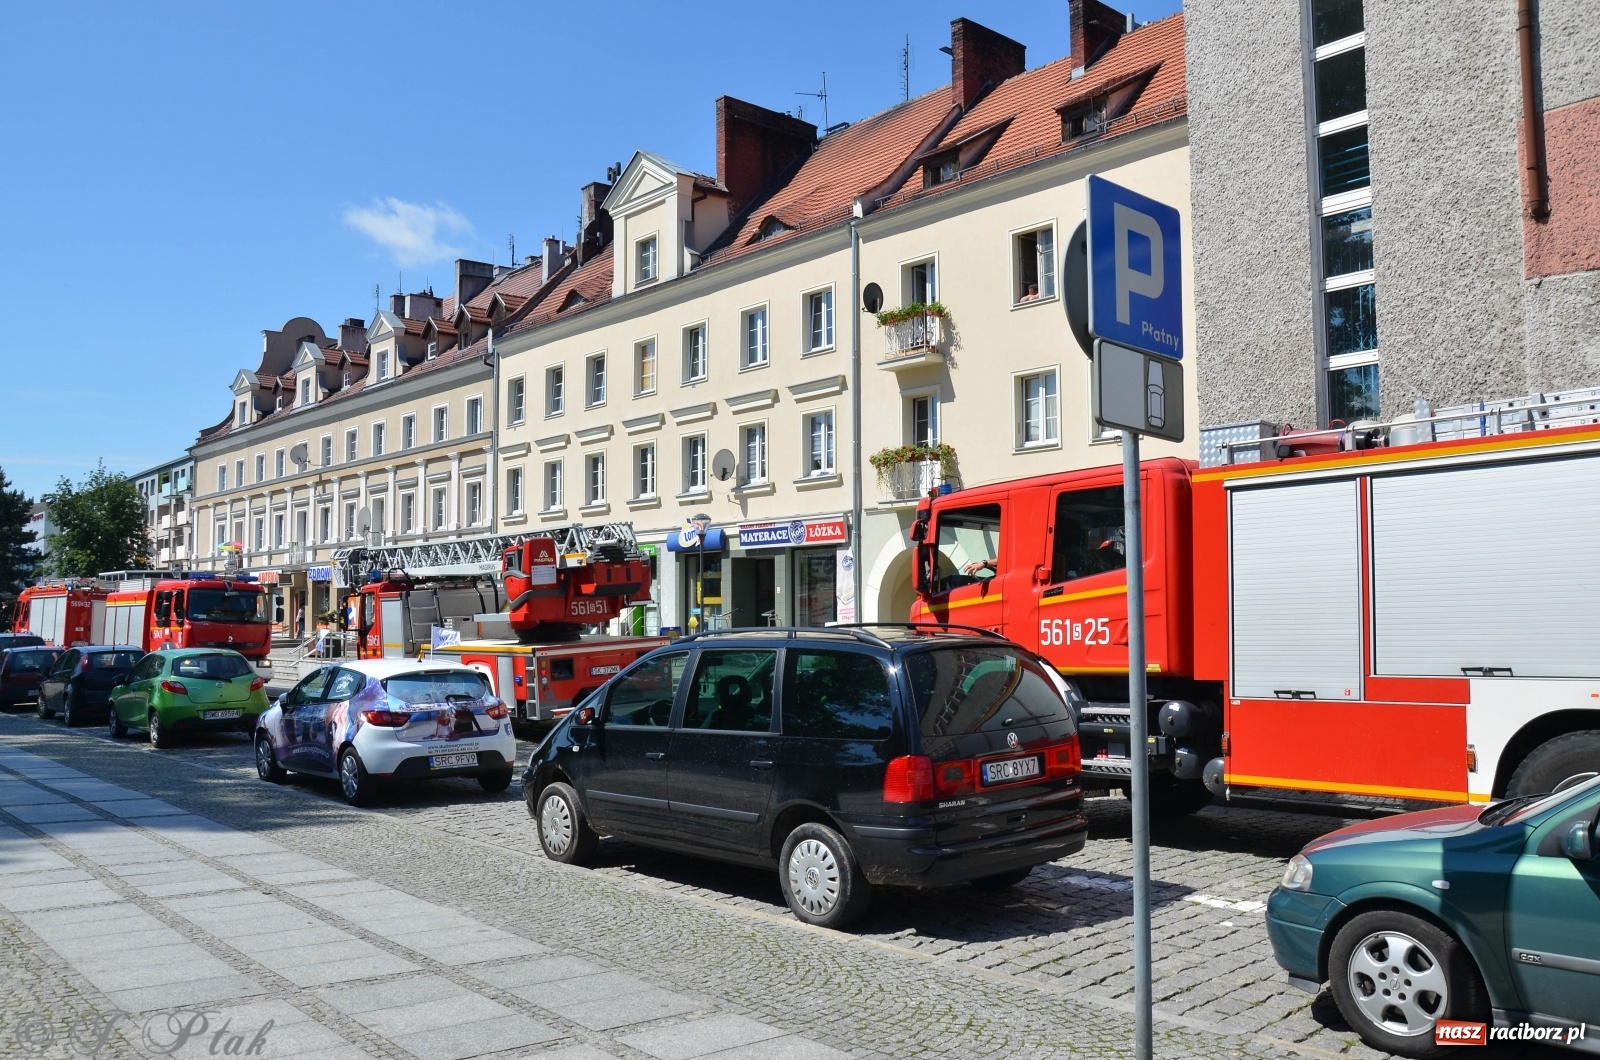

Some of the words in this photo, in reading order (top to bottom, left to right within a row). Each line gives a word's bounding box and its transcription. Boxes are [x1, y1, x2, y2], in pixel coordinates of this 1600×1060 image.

[1114, 202, 1164, 325] P
[740, 530, 788, 543] MATERACE
[809, 524, 842, 538] ŁÓŻKA
[479, 563, 496, 571] MAGIRUS
[435, 755, 453, 766] SRC
[456, 753, 476, 764] 9FV9
[989, 763, 1009, 781] SRC
[1012, 758, 1036, 777] 8YX7
[1083, 789, 1105, 798] CANIA
[938, 800, 966, 809] SHARAN
